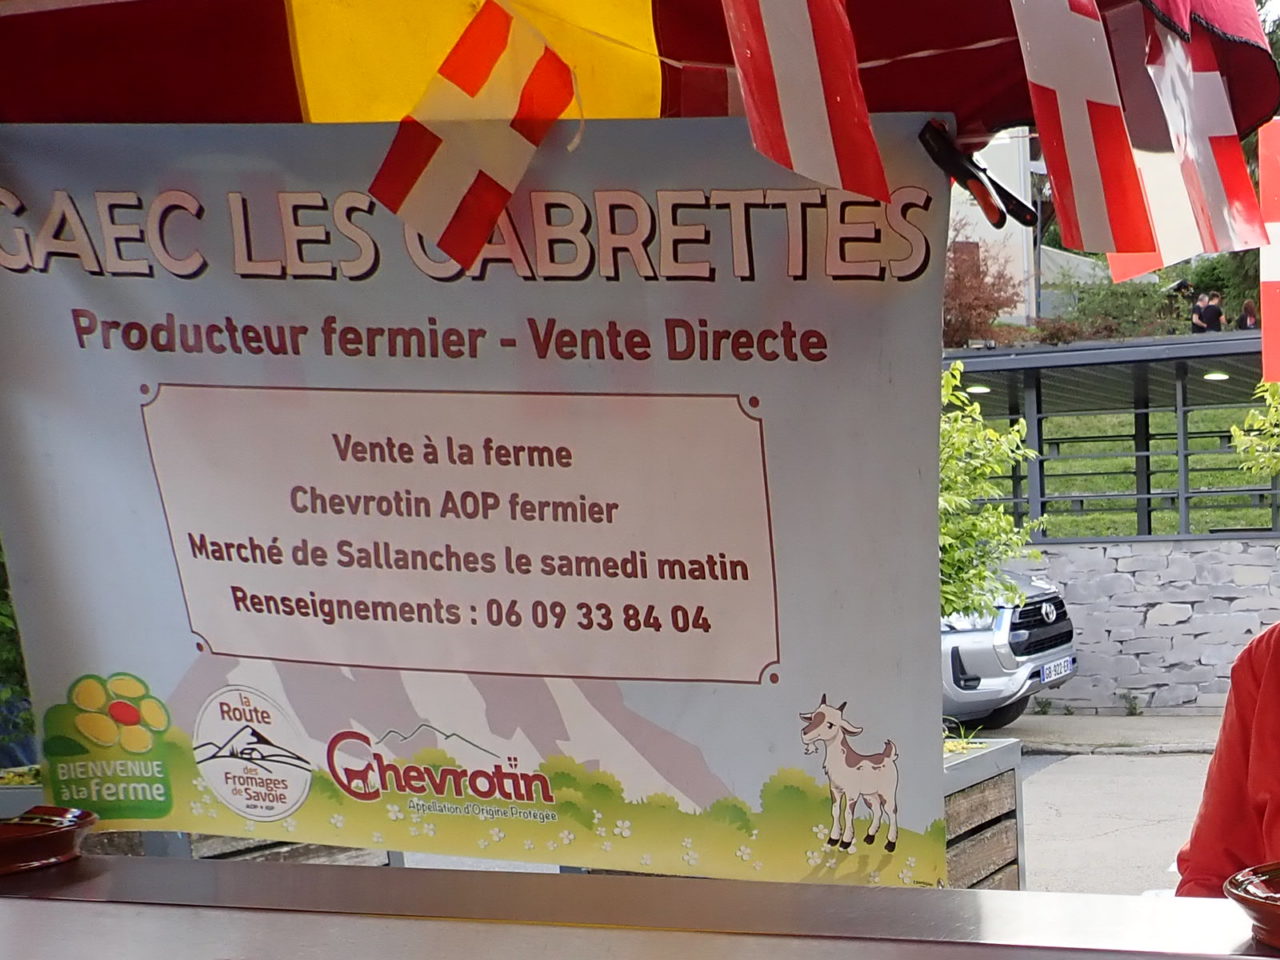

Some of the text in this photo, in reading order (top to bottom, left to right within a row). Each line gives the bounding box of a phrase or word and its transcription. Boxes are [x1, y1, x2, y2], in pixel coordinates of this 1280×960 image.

[0, 188, 209, 279] GAEC
[227, 190, 380, 281] LES
[71, 308, 308, 355] Producteur
[322, 316, 487, 359] fermier
[527, 318, 652, 361] Vente
[665, 318, 828, 362] Directe
[332, 433, 573, 468] Vente à la ferme
[290, 485, 619, 524] Chevrotin AOP fermier
[188, 532, 749, 581] Marché de Sallanches le samedi matin
[231, 585, 461, 630] Renseignements
[486, 599, 522, 628] 06
[531, 602, 567, 630] 09
[577, 603, 613, 632] 33
[623, 604, 661, 633] 84
[671, 605, 712, 634] 04
[240, 693, 251, 706] la
[219, 702, 271, 725] Route
[57, 761, 164, 780] BIENVENUE
[243, 765, 259, 776] des
[327, 731, 555, 803] Chevrotin
[61, 779, 166, 801] à la ferme
[224, 772, 288, 791] Fromages
[231, 786, 287, 804] de Savoie
[408, 800, 462, 815] Appellation
[464, 803, 508, 819] d'Origine
